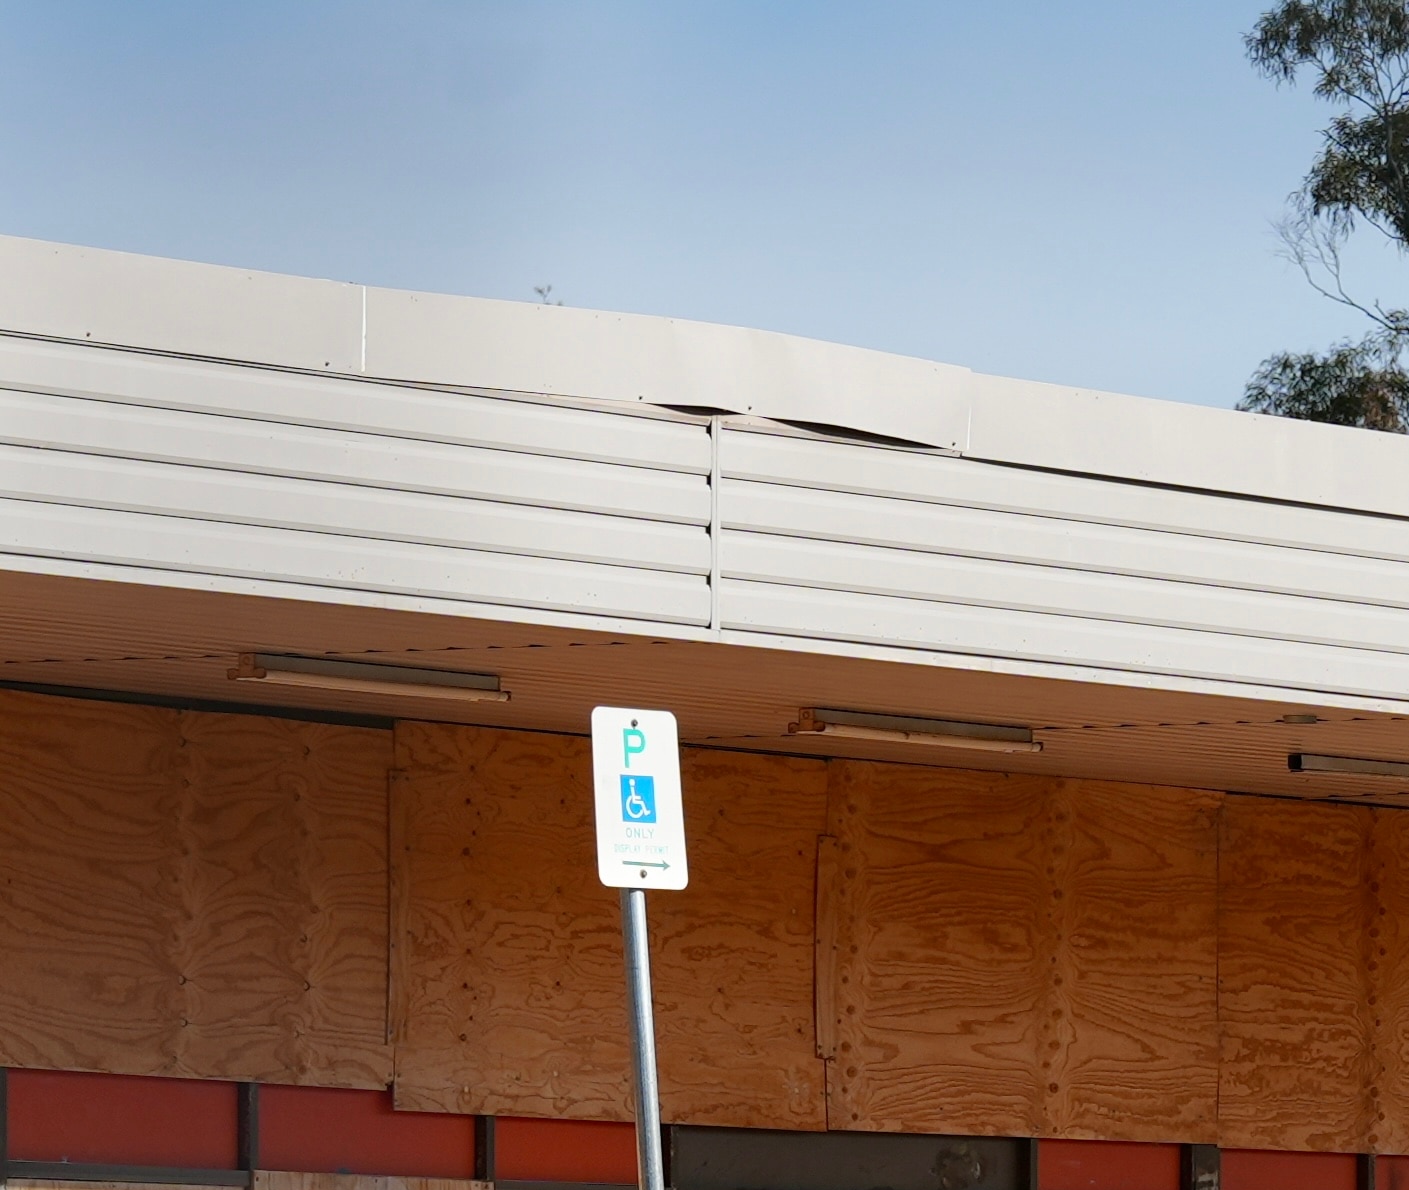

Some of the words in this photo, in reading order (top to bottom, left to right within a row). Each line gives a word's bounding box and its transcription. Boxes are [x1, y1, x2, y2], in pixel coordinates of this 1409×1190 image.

[623, 728, 646, 768] P
[626, 827, 655, 839] ONLY
[614, 844, 641, 854] DISPLAY
